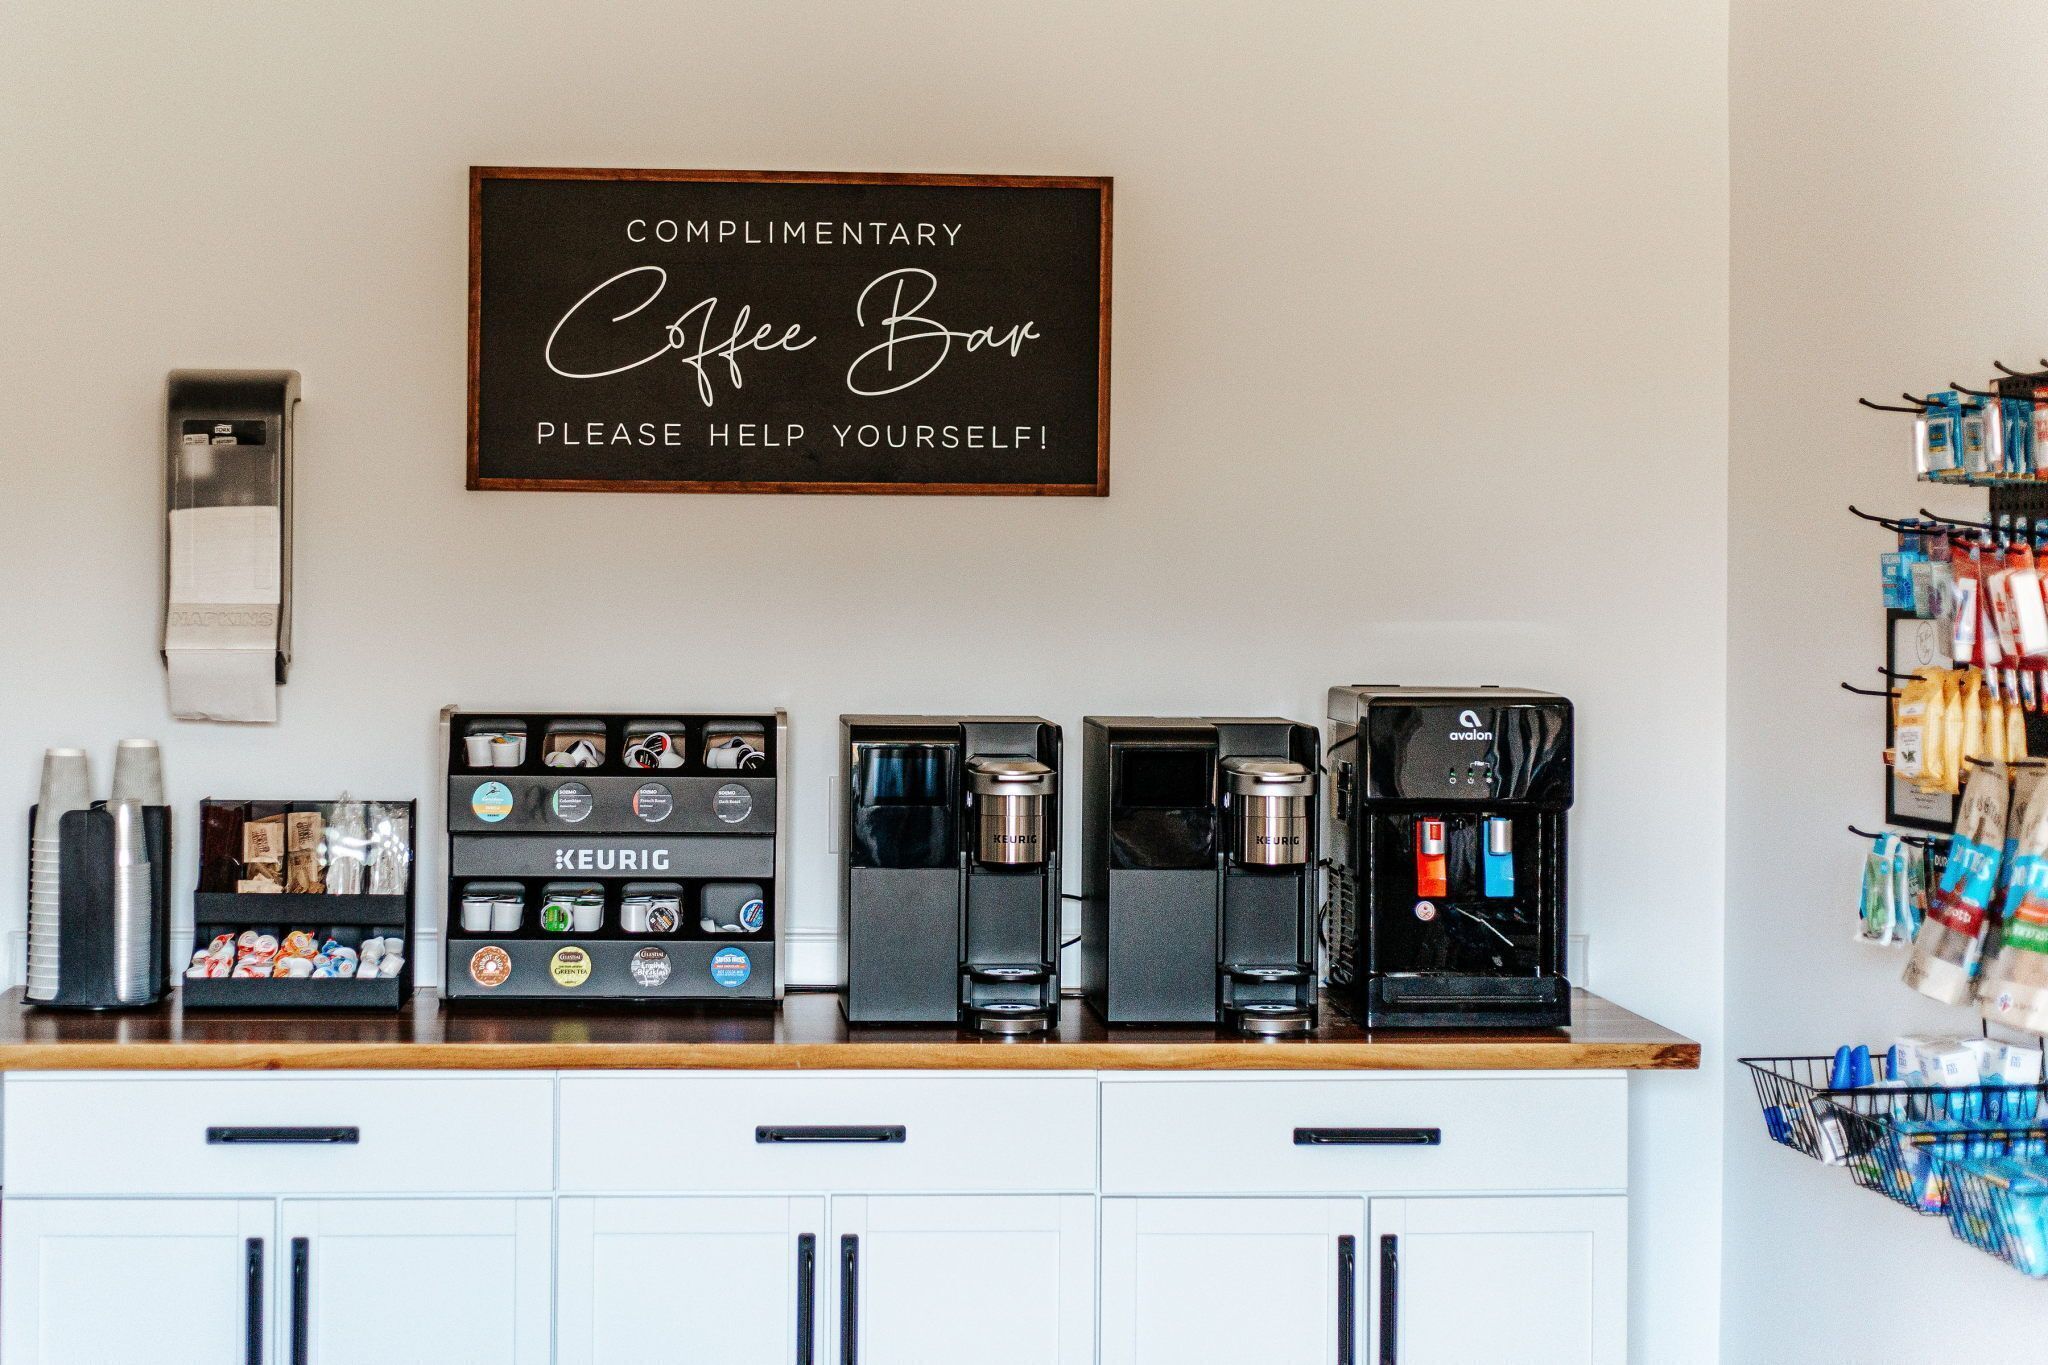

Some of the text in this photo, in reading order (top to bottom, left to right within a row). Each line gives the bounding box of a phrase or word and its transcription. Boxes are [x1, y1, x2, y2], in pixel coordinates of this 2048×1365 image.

[626, 218, 963, 247] COMPLIMENTARY
[545, 265, 1041, 407] Coffee Bar
[536, 421, 1048, 450] PLEASE HELP YOURSELF!
[171, 611, 273, 627] NAPKINS
[1449, 728, 1493, 741] avalon
[993, 834, 1037, 844] KEURIG
[1256, 835, 1300, 845] KEURIG
[555, 849, 670, 870] KEURIG
[554, 967, 576, 975] GREEN
